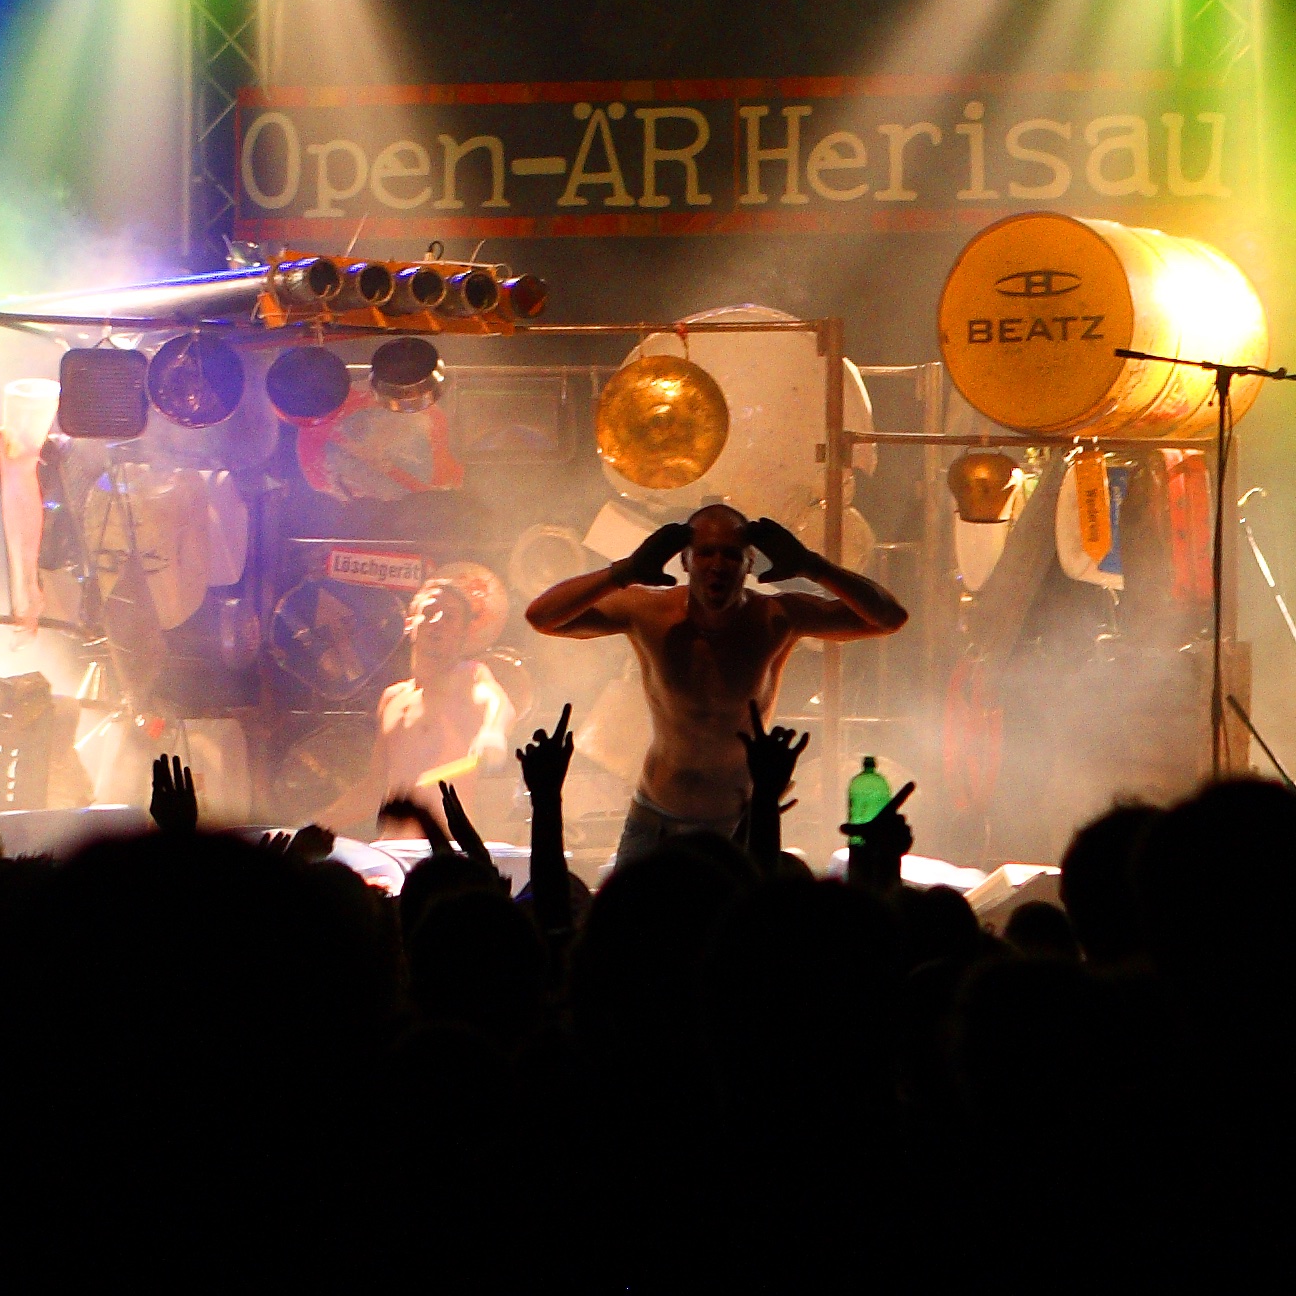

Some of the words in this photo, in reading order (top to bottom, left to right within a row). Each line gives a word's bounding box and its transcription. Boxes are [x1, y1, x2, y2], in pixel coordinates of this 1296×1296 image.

[240, 102, 713, 219] Open-ÄR
[739, 102, 1233, 204] Herisau
[968, 315, 1105, 344] BEATZ
[333, 554, 422, 581] Löschgerät
